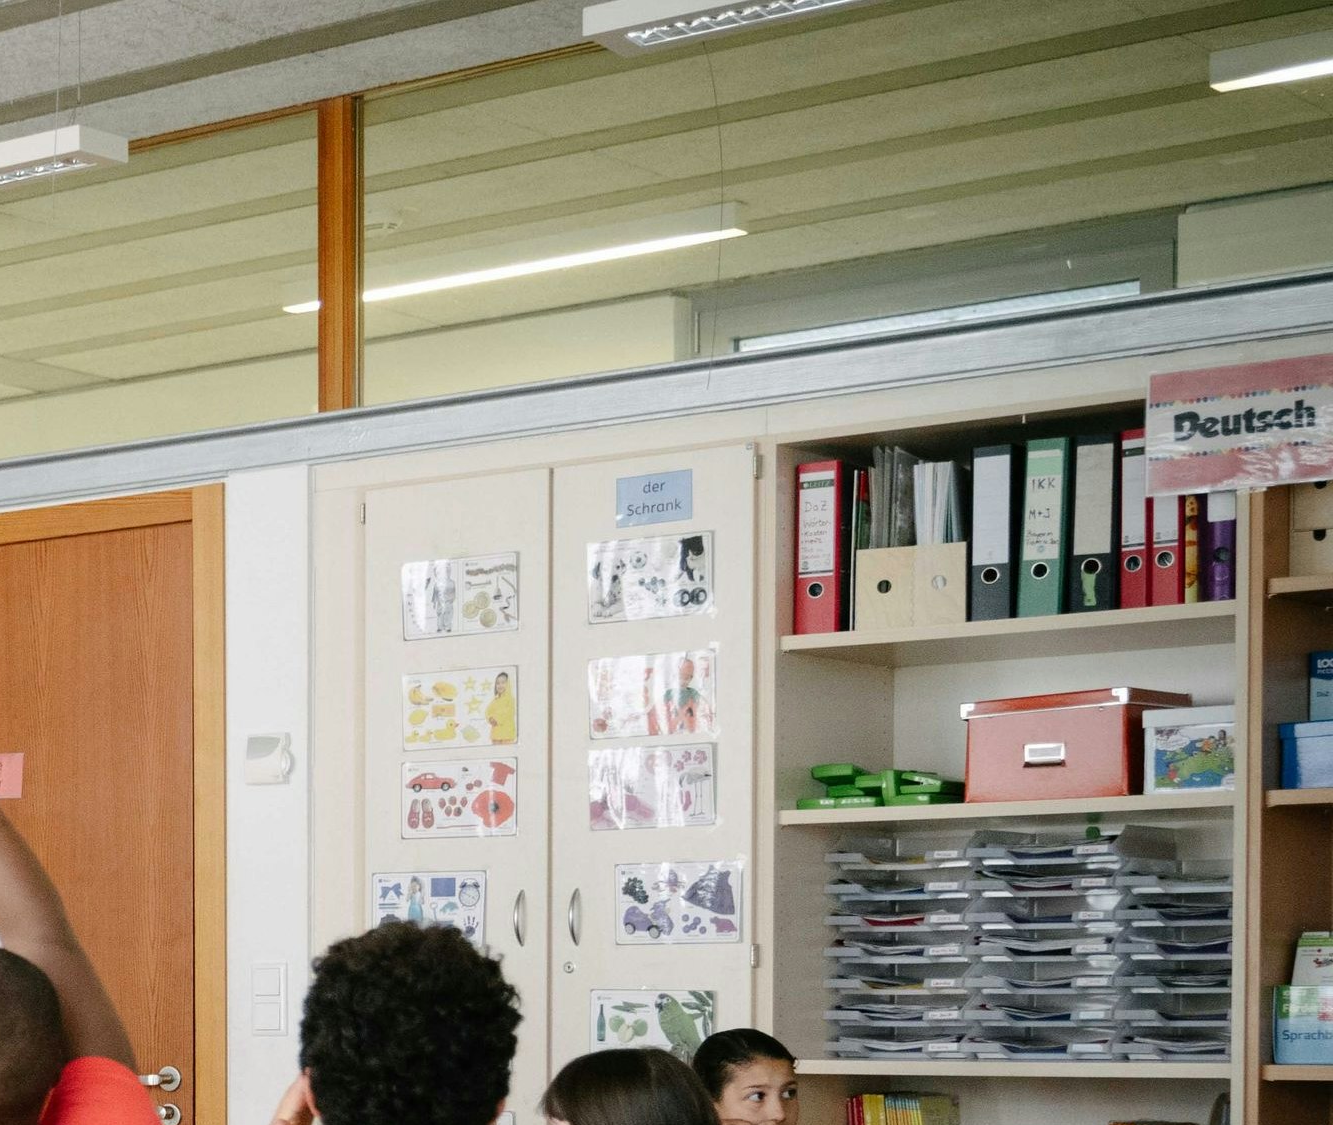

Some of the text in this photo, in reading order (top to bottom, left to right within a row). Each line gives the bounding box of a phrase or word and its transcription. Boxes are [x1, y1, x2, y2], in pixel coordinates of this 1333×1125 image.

[1174, 399, 1316, 442] Deutsch
[643, 481, 666, 494] der
[627, 498, 683, 517] Schrank
[1282, 1030, 1333, 1042] Sprachb
